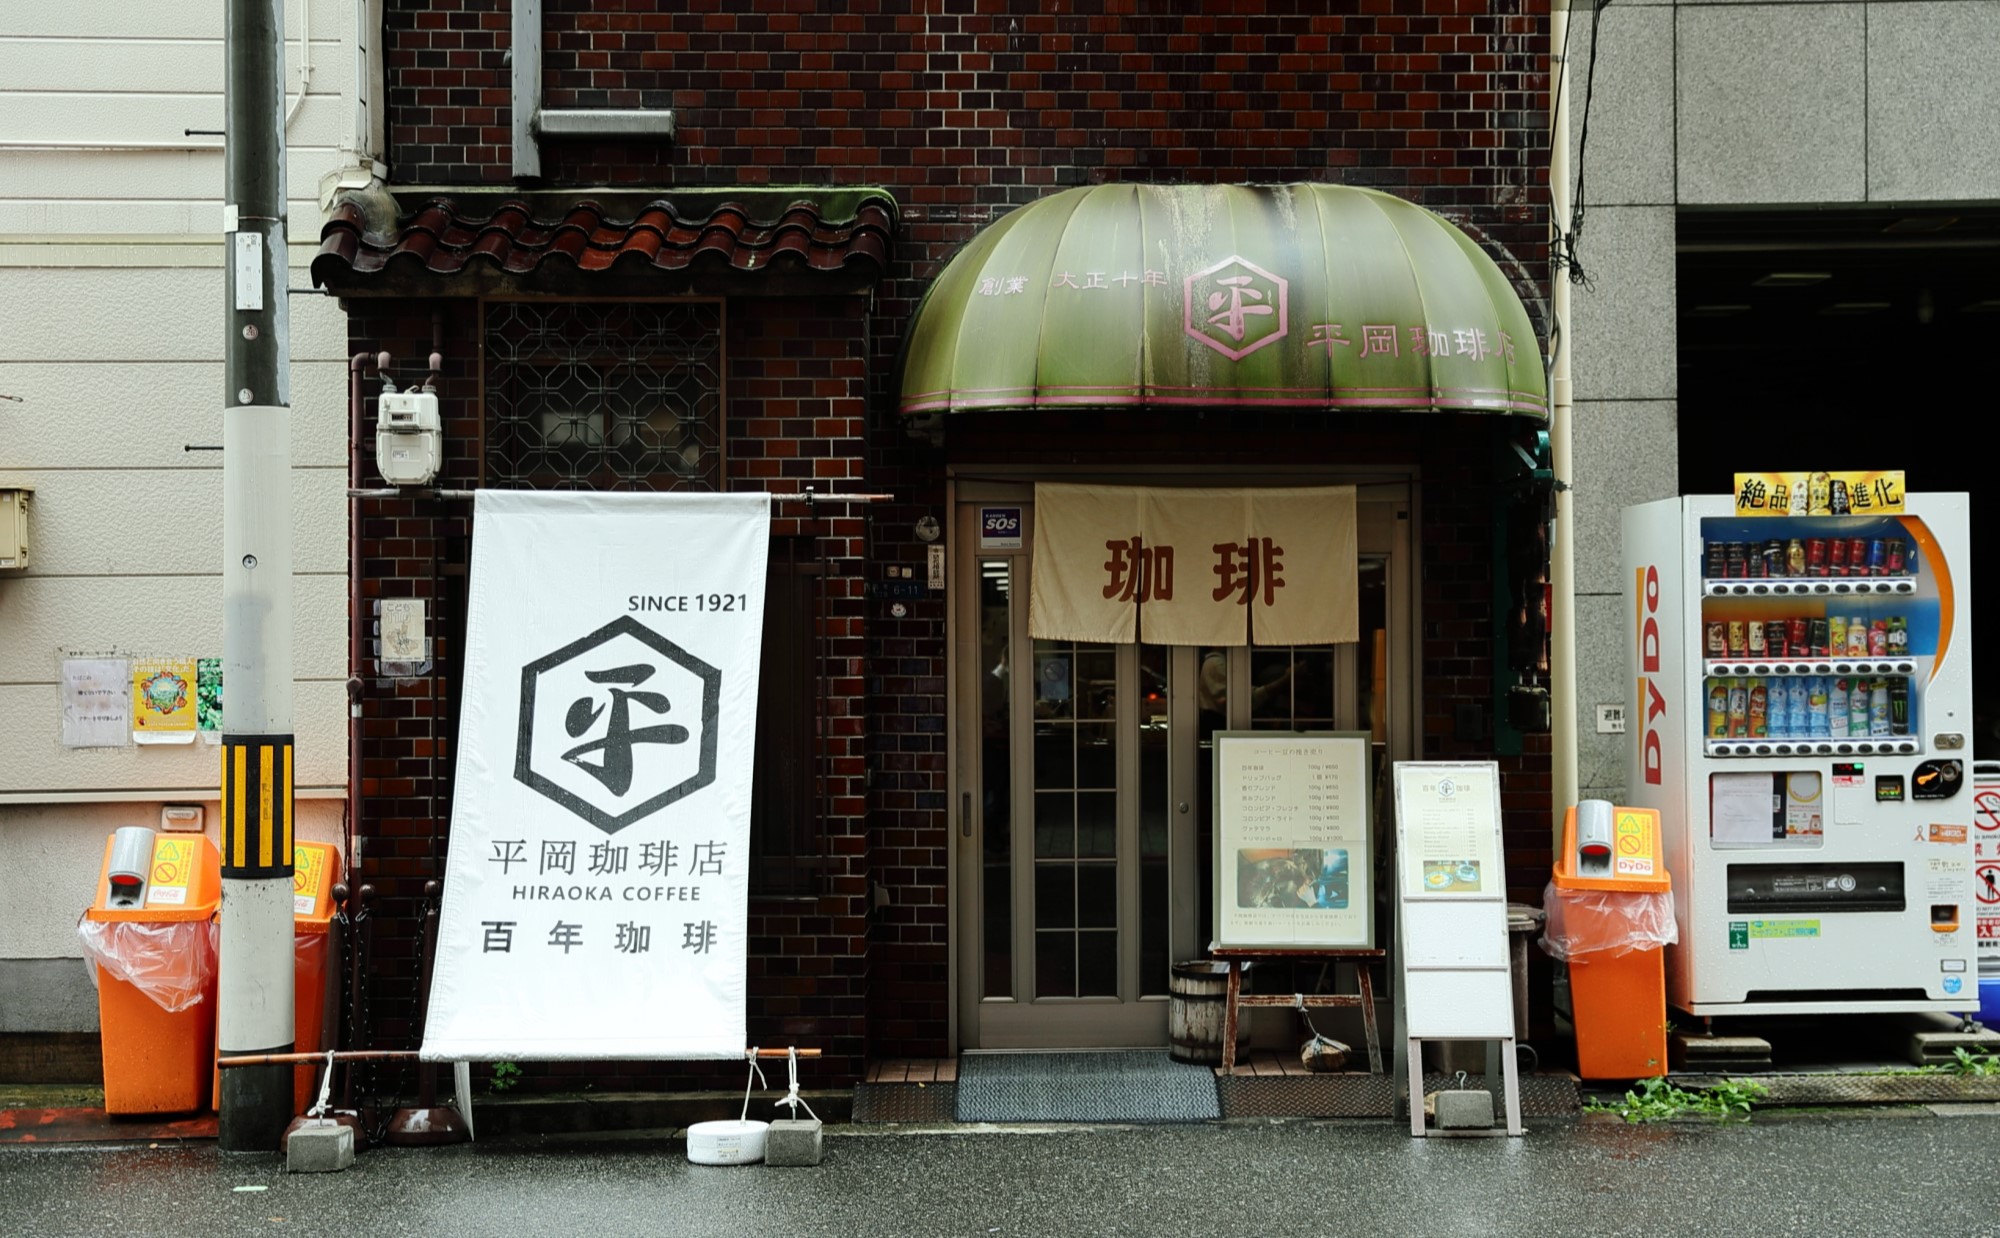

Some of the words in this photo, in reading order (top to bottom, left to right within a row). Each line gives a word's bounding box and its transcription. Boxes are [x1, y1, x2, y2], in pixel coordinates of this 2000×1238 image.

[978, 276, 1029, 297] 創業
[1053, 268, 1168, 290] 大正十年
[1307, 322, 1516, 366] 平岡珈琲店
[1737, 478, 1789, 510] 絶品
[1850, 478, 1902, 509] 進化
[985, 518, 1018, 530] SOS
[1103, 536, 1286, 606] 珈琲
[628, 595, 689, 612] SINCE
[695, 593, 747, 612] 1921
[561, 662, 690, 797] 平
[487, 838, 728, 877] 平岡珈琲店
[1619, 862, 1651, 871] DyDo
[511, 885, 613, 901] HIRAOKA
[622, 886, 701, 902] COFFEE
[481, 920, 719, 955] 百年珈琲
